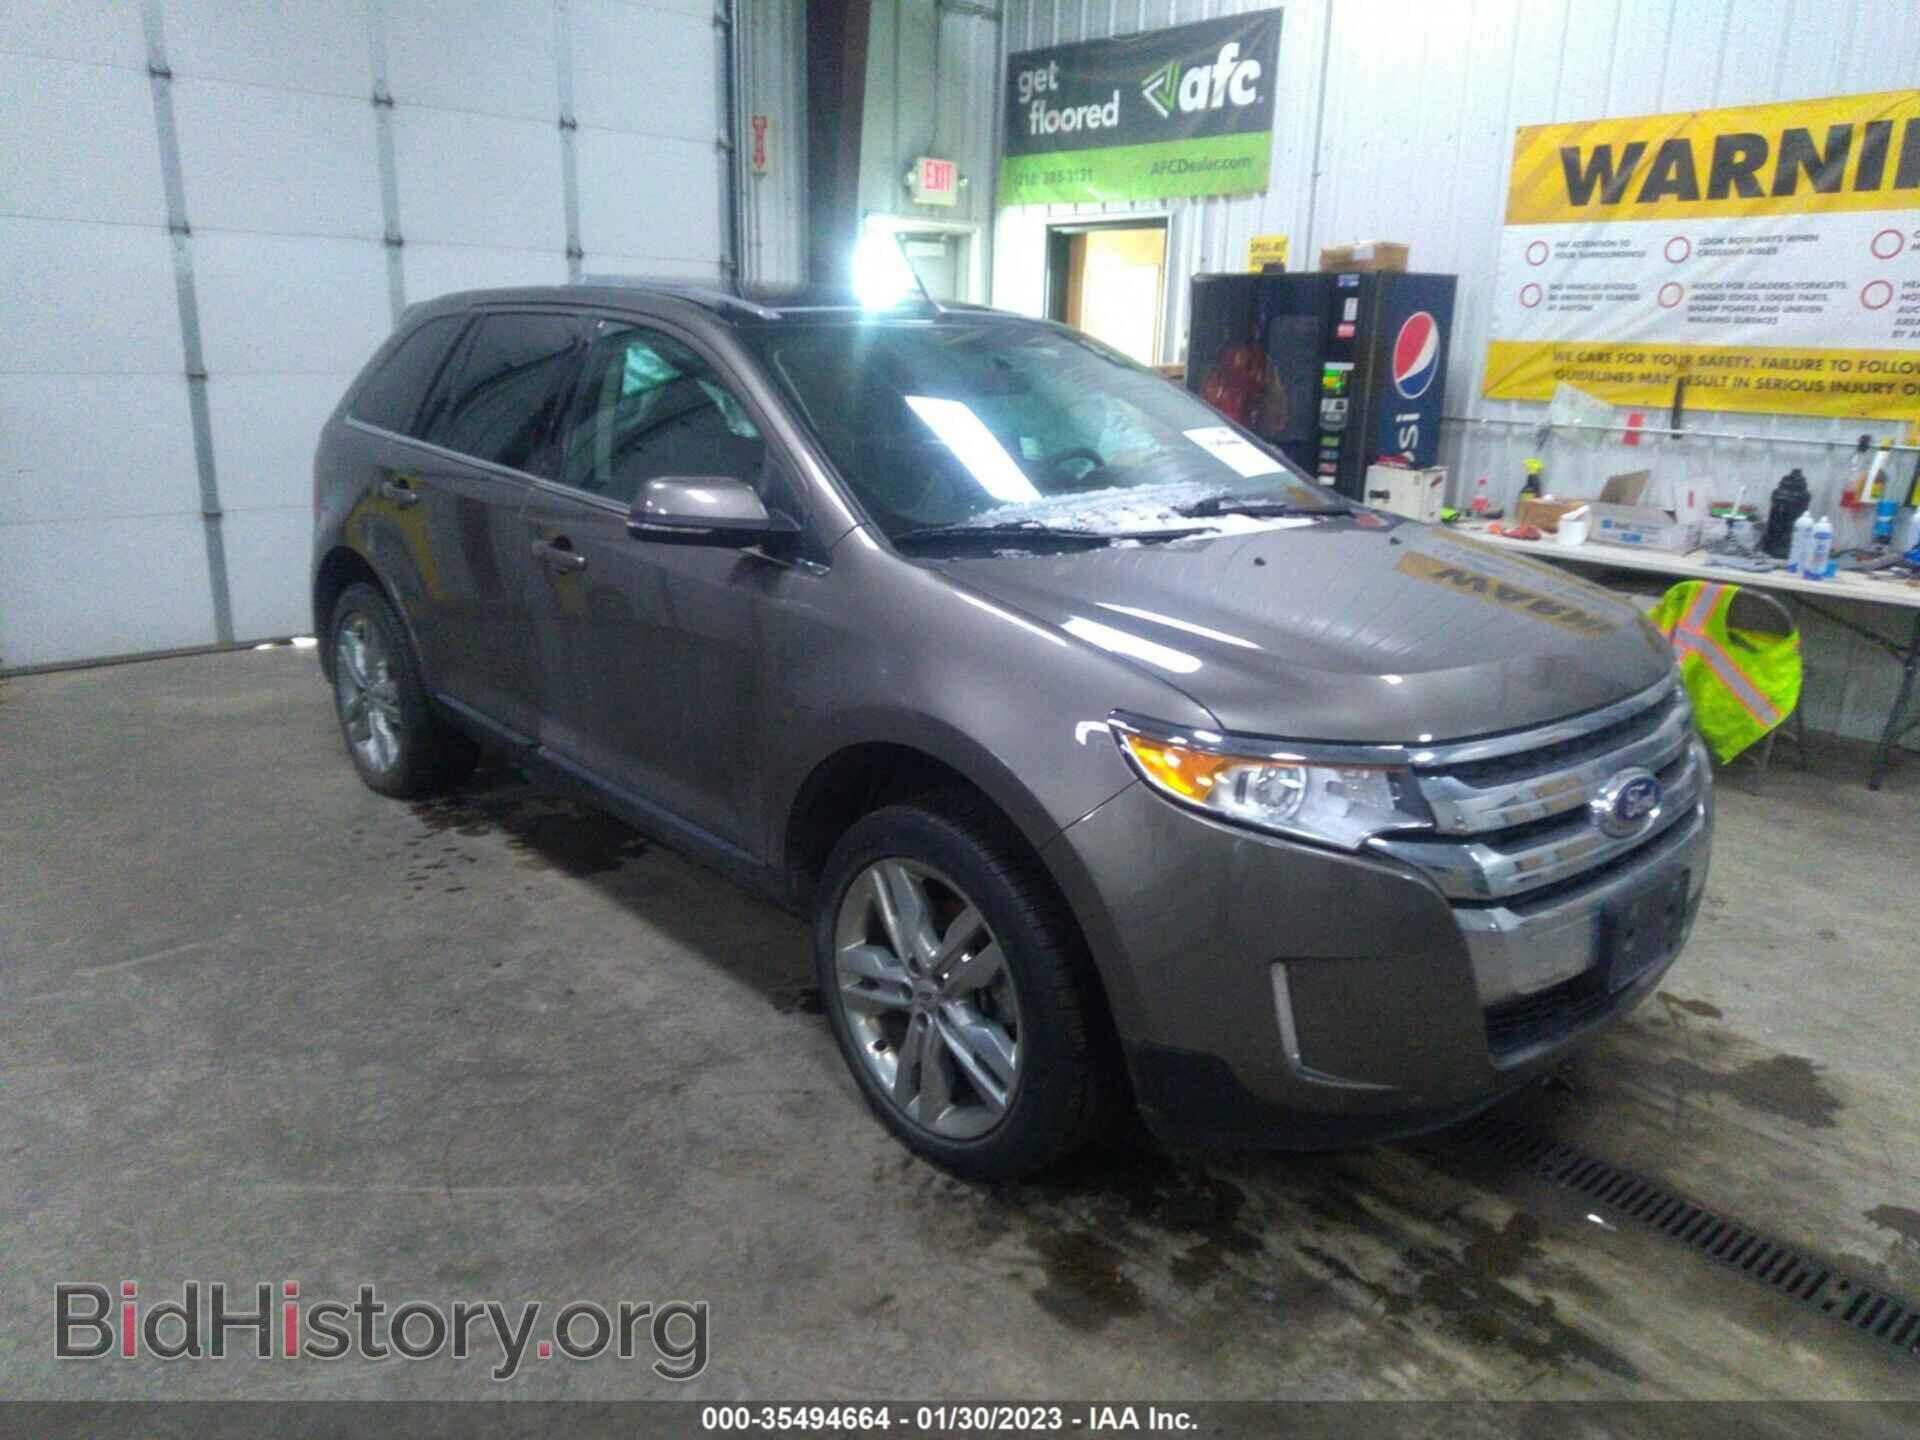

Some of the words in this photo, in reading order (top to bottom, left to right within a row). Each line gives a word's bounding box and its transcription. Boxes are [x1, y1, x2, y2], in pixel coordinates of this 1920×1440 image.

[1018, 60, 1059, 102] get
[1179, 42, 1261, 112] afc
[1028, 90, 1120, 135] floored
[924, 160, 952, 191] EXIT
[1577, 351, 1612, 363] CARE
[1616, 352, 1645, 365] FOR
[1653, 353, 1694, 367] YOUR
[1760, 356, 1823, 371] FAILURE
[1829, 359, 1852, 373] TO
[1553, 368, 1633, 383] GUIDELINES
[1638, 372, 1672, 385] MAY
[1732, 375, 1750, 389] IN
[1755, 377, 1825, 392] SERIOUS
[1829, 380, 1897, 394] INJURY
